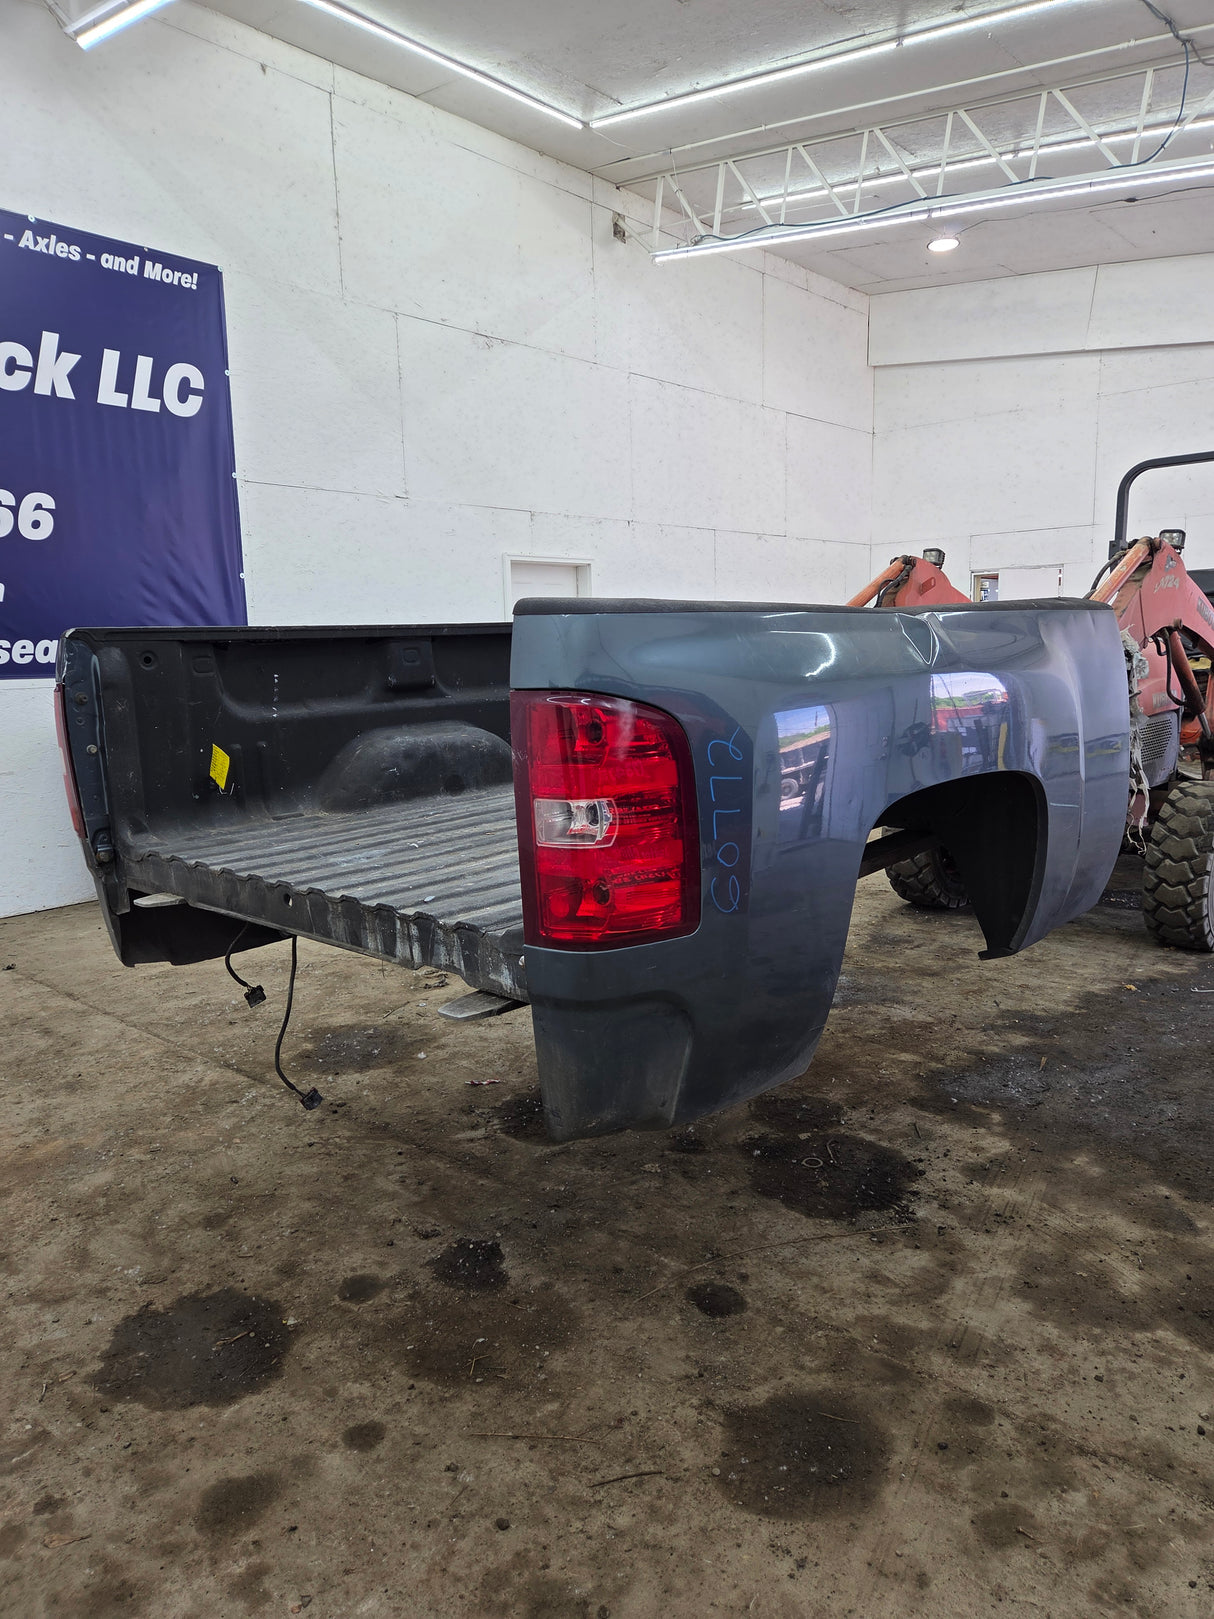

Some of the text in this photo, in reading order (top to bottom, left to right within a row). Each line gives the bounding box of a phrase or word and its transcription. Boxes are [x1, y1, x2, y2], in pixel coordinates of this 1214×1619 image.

[18, 229, 82, 261] Axles
[100, 253, 140, 276] and
[143, 260, 198, 290] More!
[0, 331, 205, 418] ck LLC
[707, 726, 743, 914] 60772
